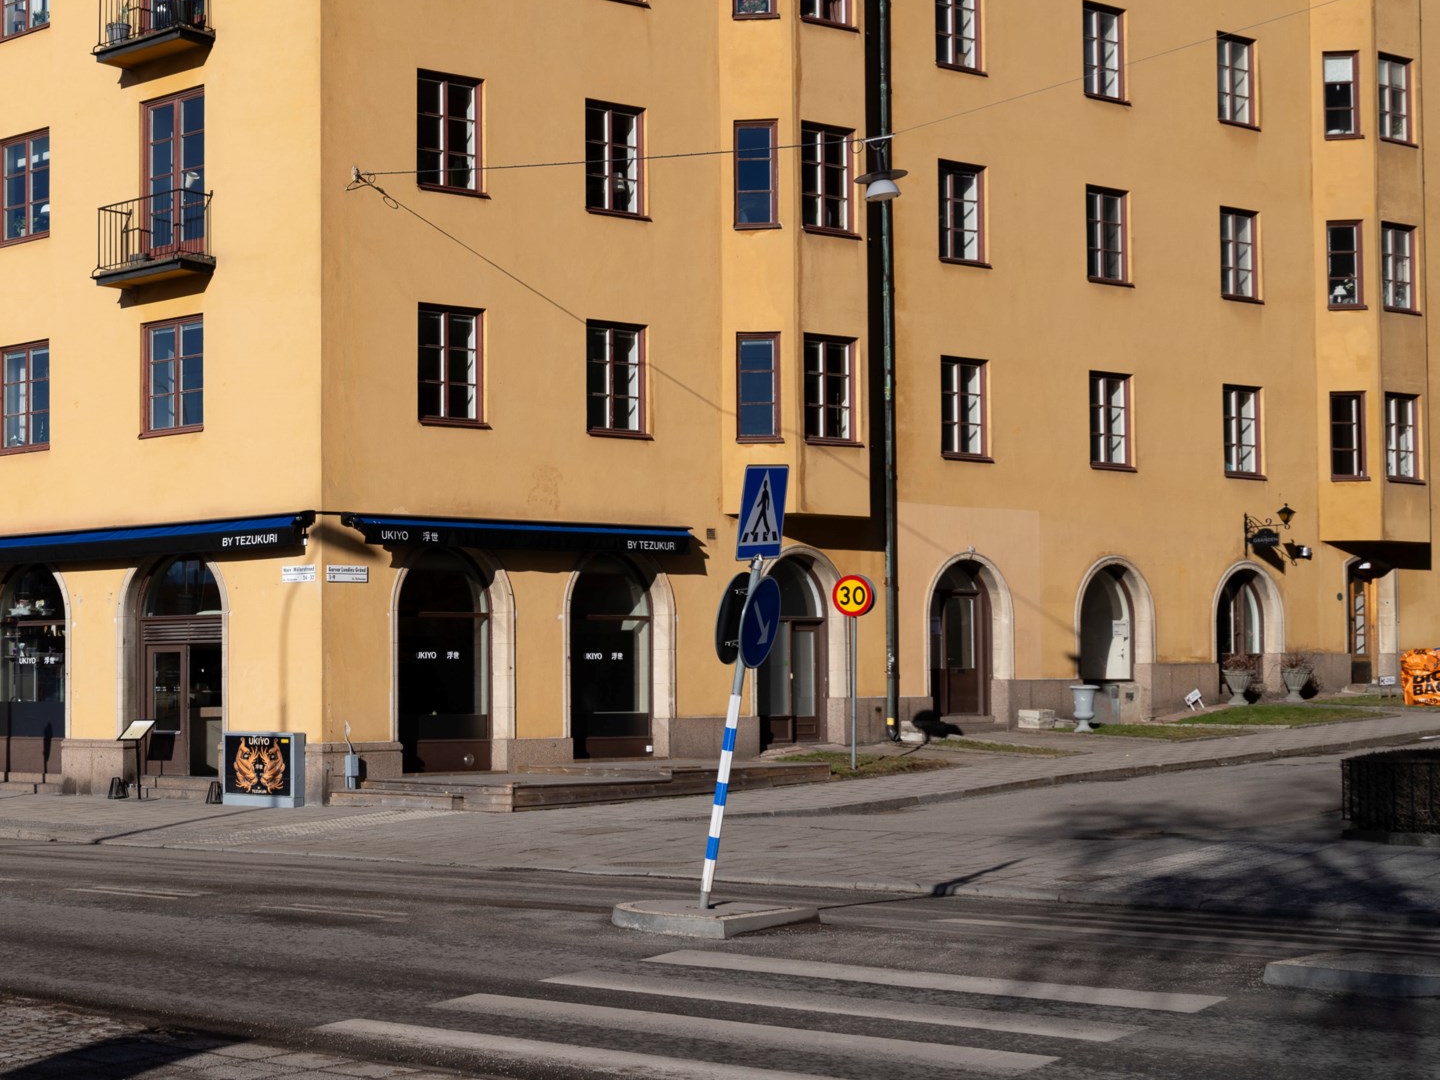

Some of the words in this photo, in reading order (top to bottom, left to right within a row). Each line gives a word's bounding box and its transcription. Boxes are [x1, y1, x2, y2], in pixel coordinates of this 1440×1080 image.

[222, 537, 233, 547] BY
[235, 533, 278, 546] TEZUKURI
[381, 530, 409, 541] UKIYO
[627, 540, 638, 549] BY
[639, 540, 677, 551] TEZUKUR
[840, 586, 866, 606] 30
[19, 657, 37, 665] UKIYO
[248, 737, 270, 746] UKIYO
